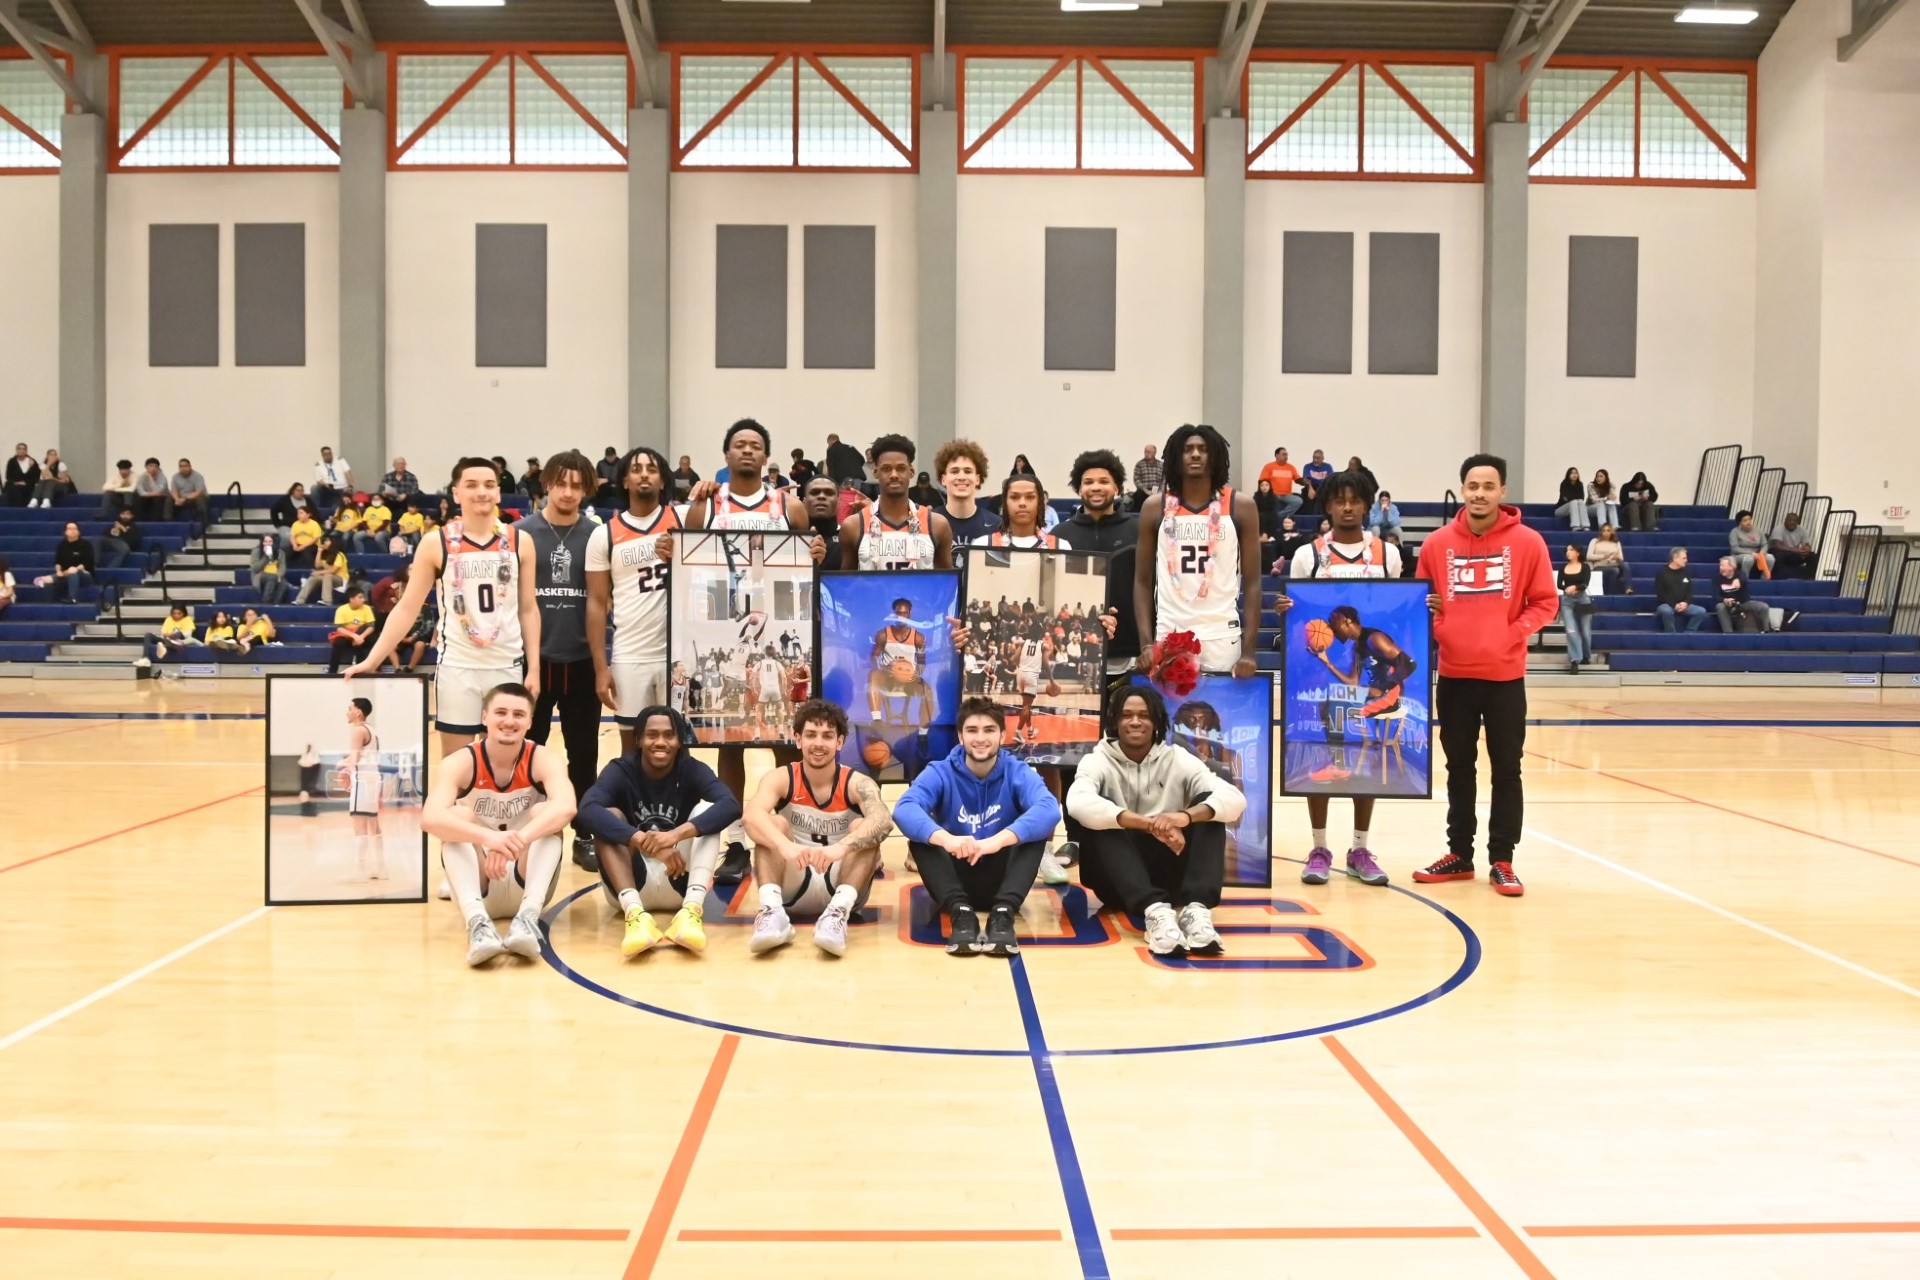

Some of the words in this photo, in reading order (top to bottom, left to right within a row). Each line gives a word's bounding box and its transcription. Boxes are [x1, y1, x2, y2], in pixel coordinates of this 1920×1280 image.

[1890, 506, 1902, 517] EXIT
[1446, 548, 1455, 602] CHAMPION
[1502, 546, 1511, 599] CHAMPION
[478, 583, 495, 613] 0
[535, 587, 588, 597] BASKETBALL
[790, 811, 849, 834] GIANTS
